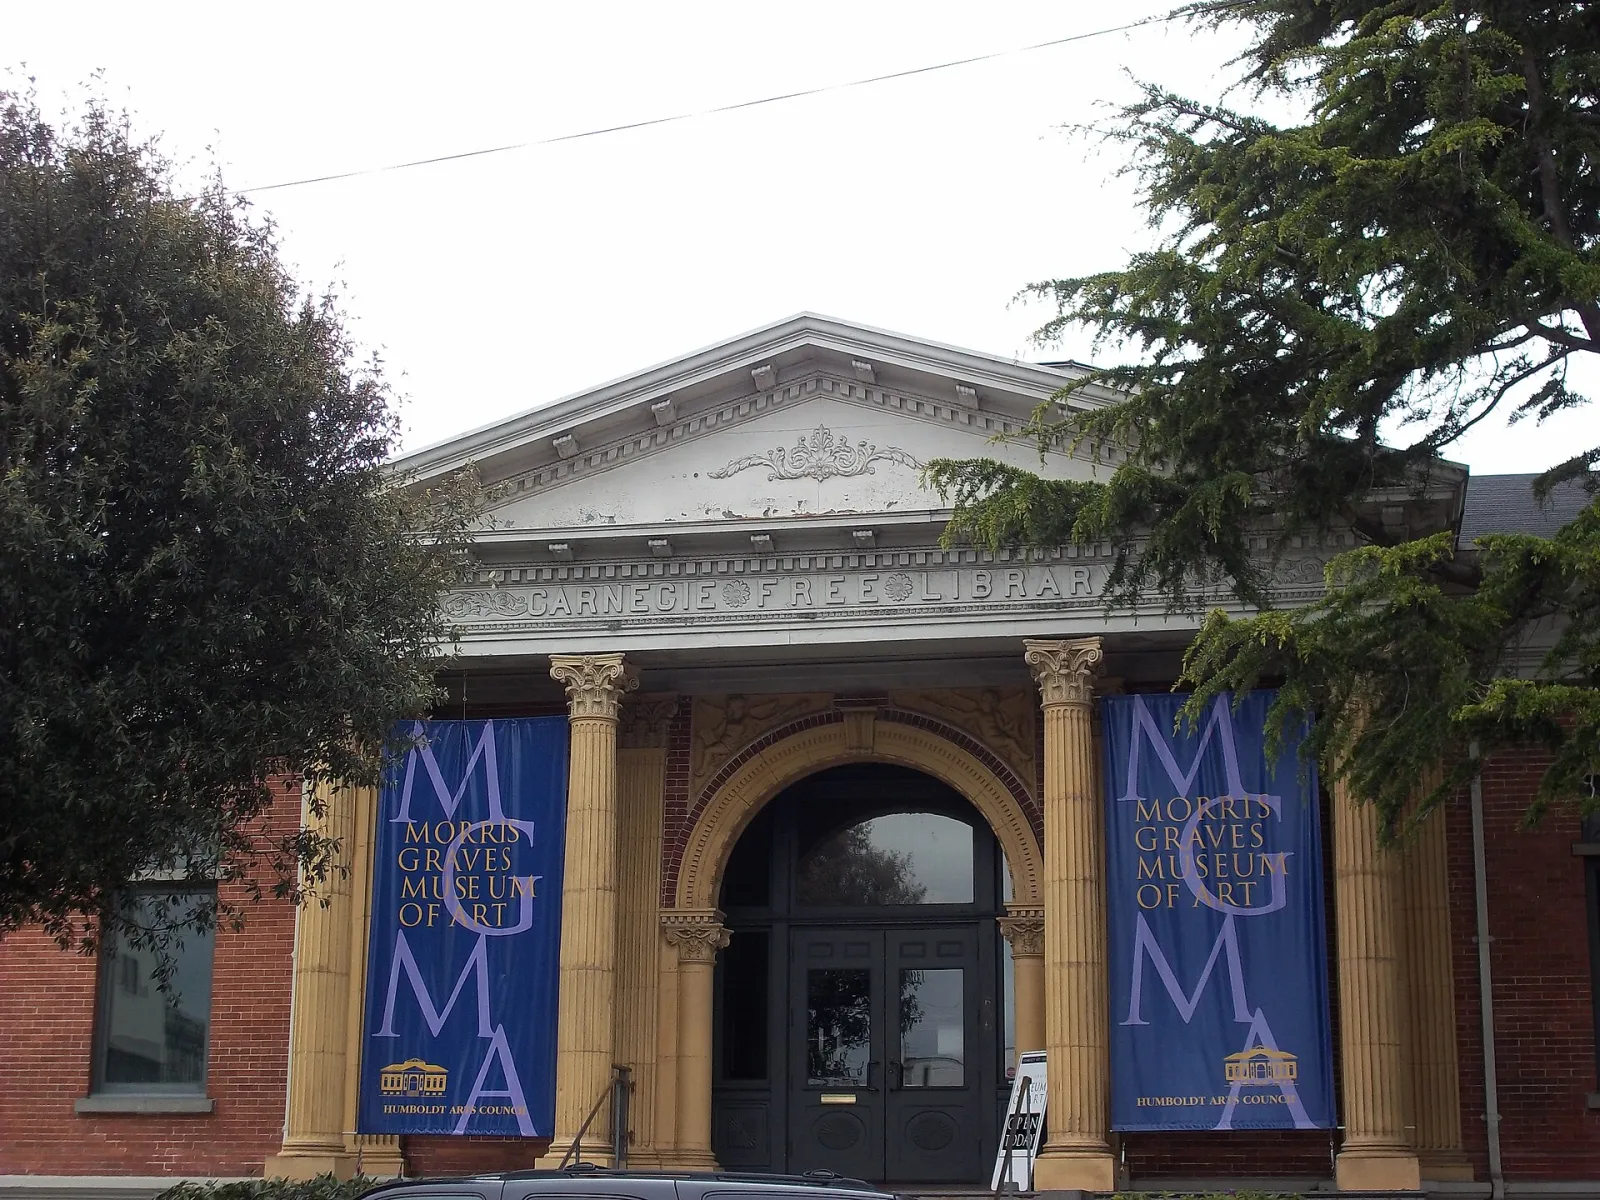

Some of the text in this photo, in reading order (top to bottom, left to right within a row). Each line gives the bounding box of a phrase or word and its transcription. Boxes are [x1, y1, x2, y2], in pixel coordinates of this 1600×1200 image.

[526, 580, 716, 617] CARNEGIE
[757, 574, 880, 608] FREE
[1135, 795, 1271, 823] MORRIS
[404, 820, 520, 844] MORRIS
[1135, 823, 1264, 851] GRAVES
[398, 847, 512, 872] GRAVES
[1136, 851, 1289, 880] MUSEUM
[400, 874, 538, 900] MUSEUM
[1136, 882, 1258, 909] OF ART
[399, 903, 507, 927] OF ART
[383, 1105, 447, 1115] HUMBOLDT
[1136, 1096, 1206, 1107] HUMBOLDT
